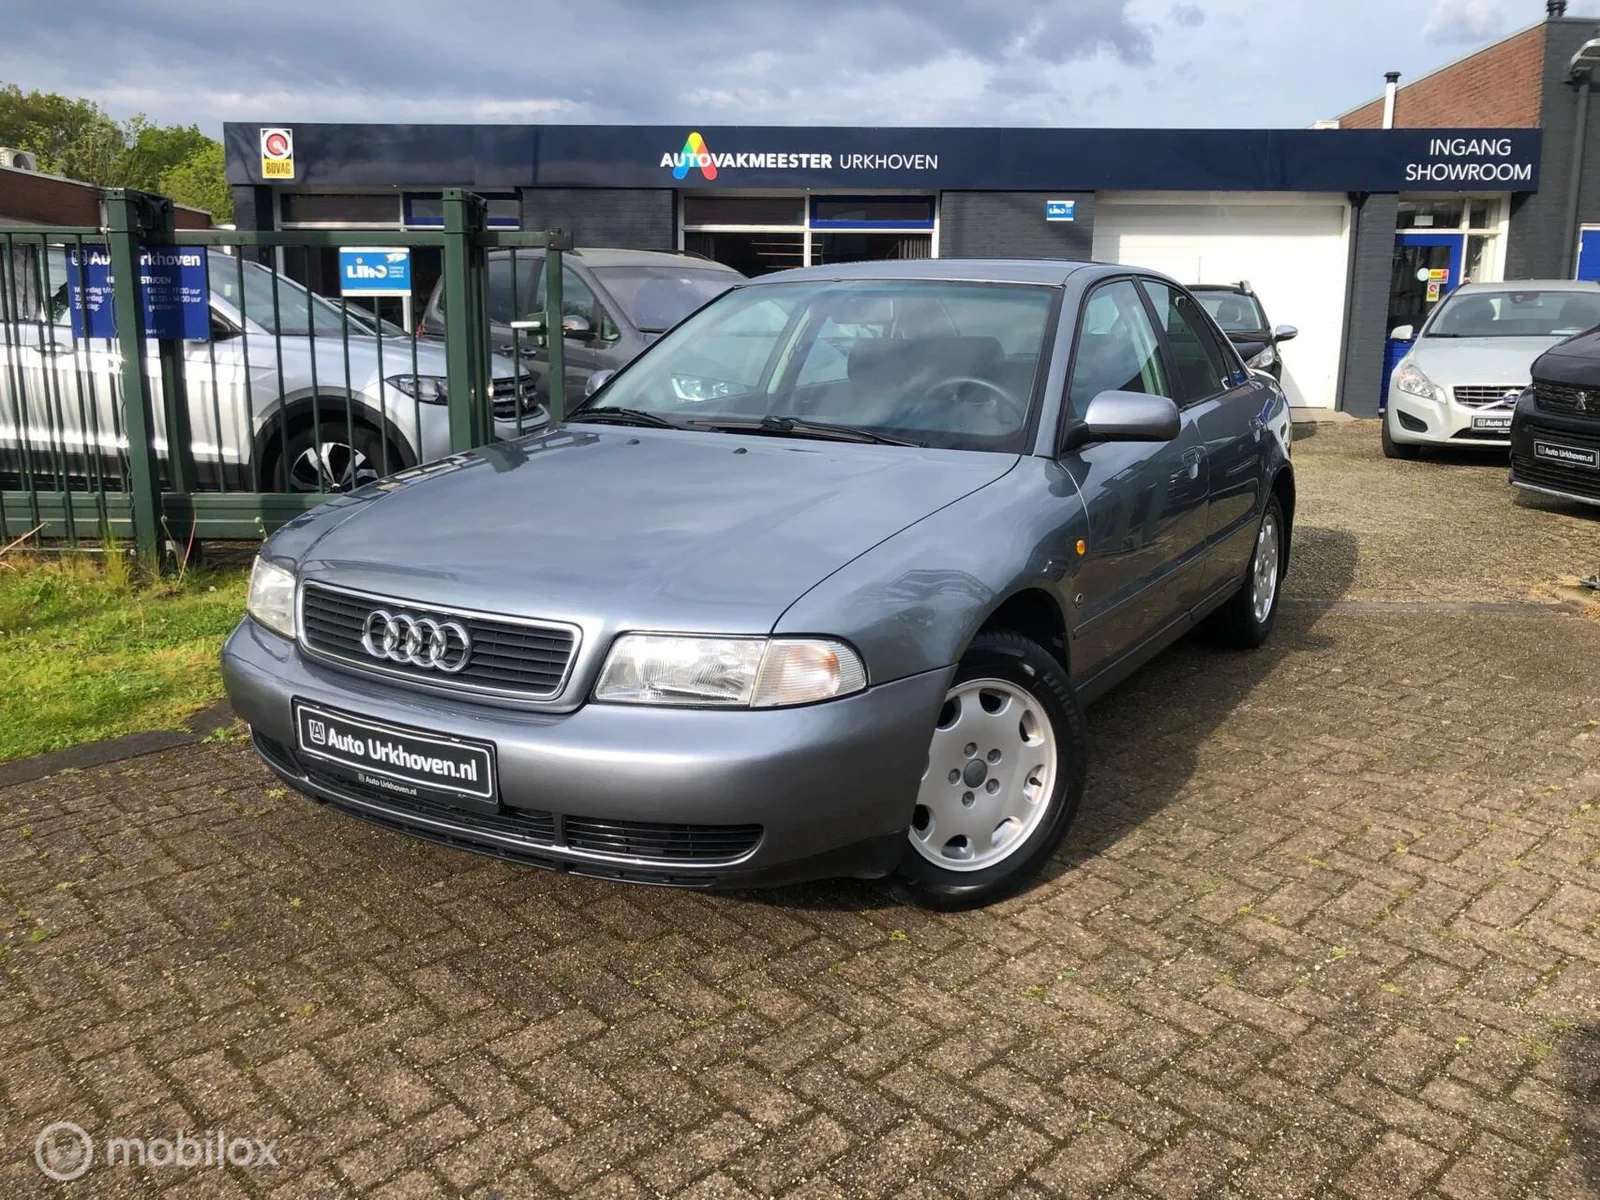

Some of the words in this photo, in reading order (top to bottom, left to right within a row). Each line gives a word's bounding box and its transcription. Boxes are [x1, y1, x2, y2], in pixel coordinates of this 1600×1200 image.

[1430, 138, 1512, 156] INGANG
[266, 162, 290, 174] BOVAG
[660, 153, 832, 168] AUTOVAKMEESTER
[840, 154, 938, 170] URKHOVEN
[1405, 163, 1532, 181] SHOWROOM
[140, 252, 200, 267] rkhoven
[1485, 419, 1503, 427] Auto
[1545, 446, 1559, 457] Auto
[1559, 449, 1594, 463] Urkhoven.nl
[328, 727, 365, 756] Auto
[368, 738, 478, 781] Urkhoven.nl
[365, 775, 380, 787] Auto
[380, 779, 418, 796] Urkhoven.nl
